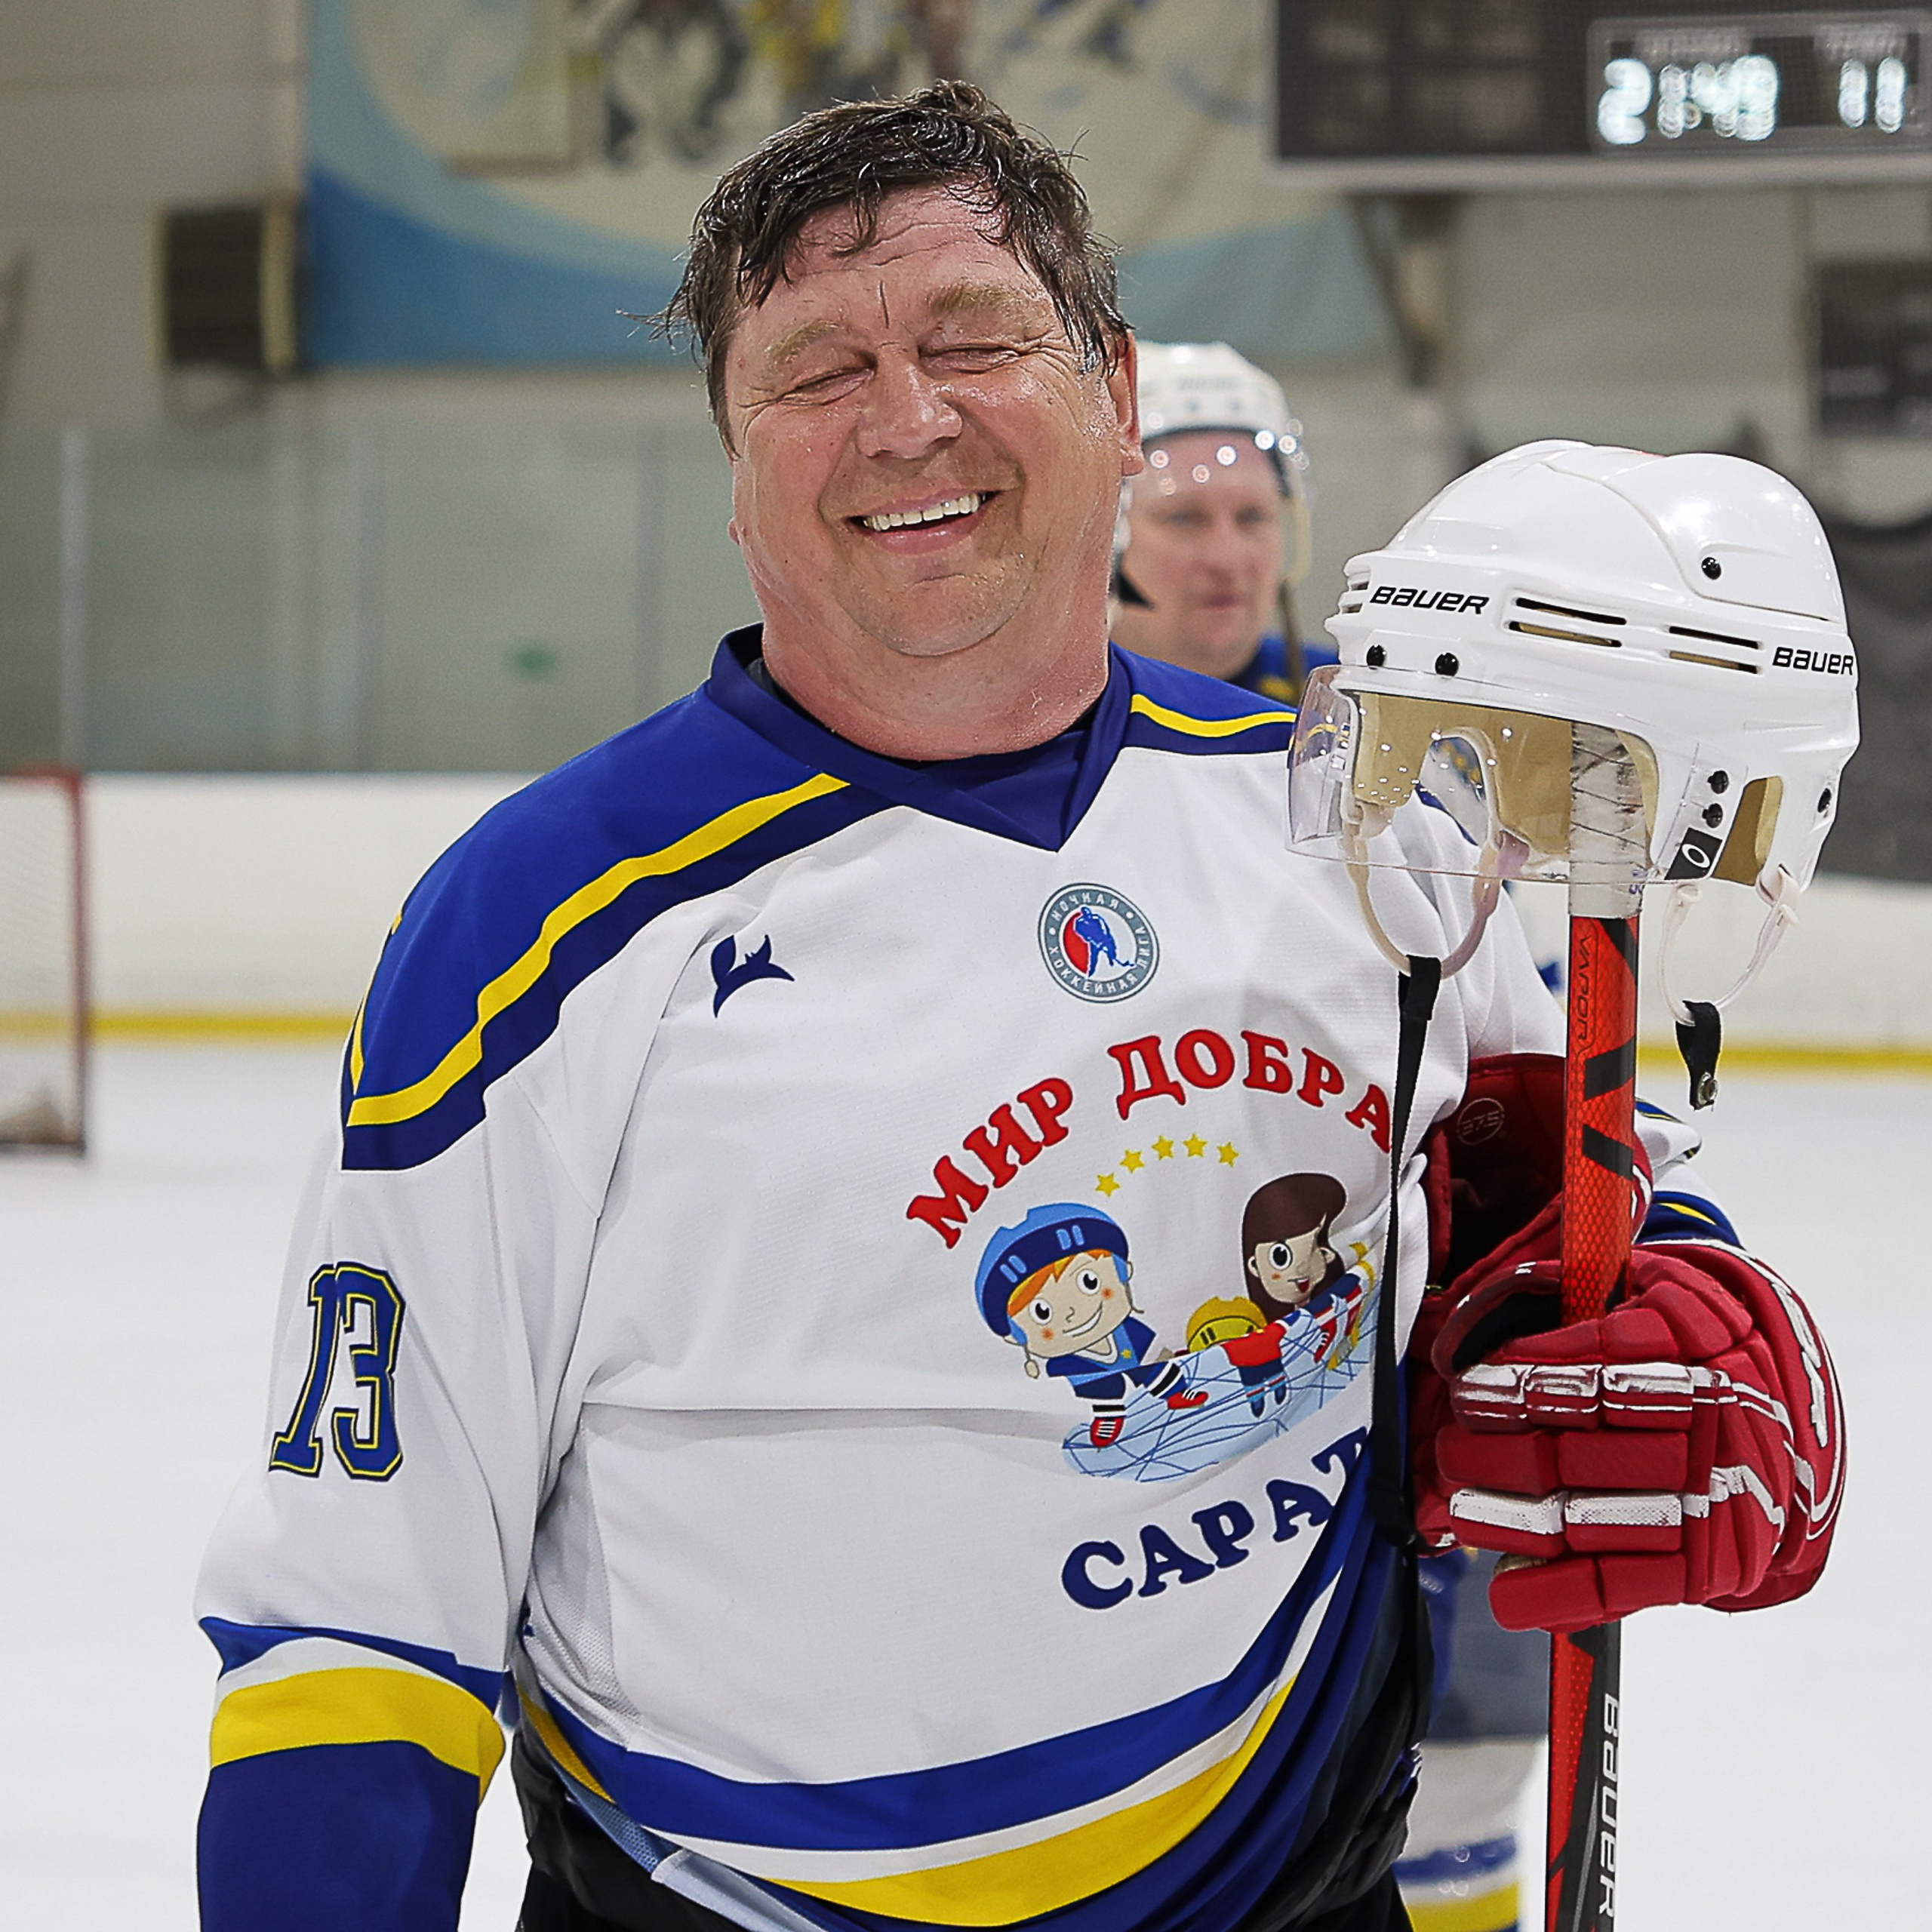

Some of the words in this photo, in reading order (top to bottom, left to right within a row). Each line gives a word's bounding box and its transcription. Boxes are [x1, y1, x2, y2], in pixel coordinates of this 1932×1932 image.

[1050, 892, 1120, 921] НОЧНАЯ
[1134, 925, 1151, 971] ЛИГА
[1577, 935, 1593, 1041] VAPOR
[906, 1077, 1073, 1249] МИР
[1107, 1029, 1394, 1154] ДОБРА
[268, 1261, 407, 1483] 13
